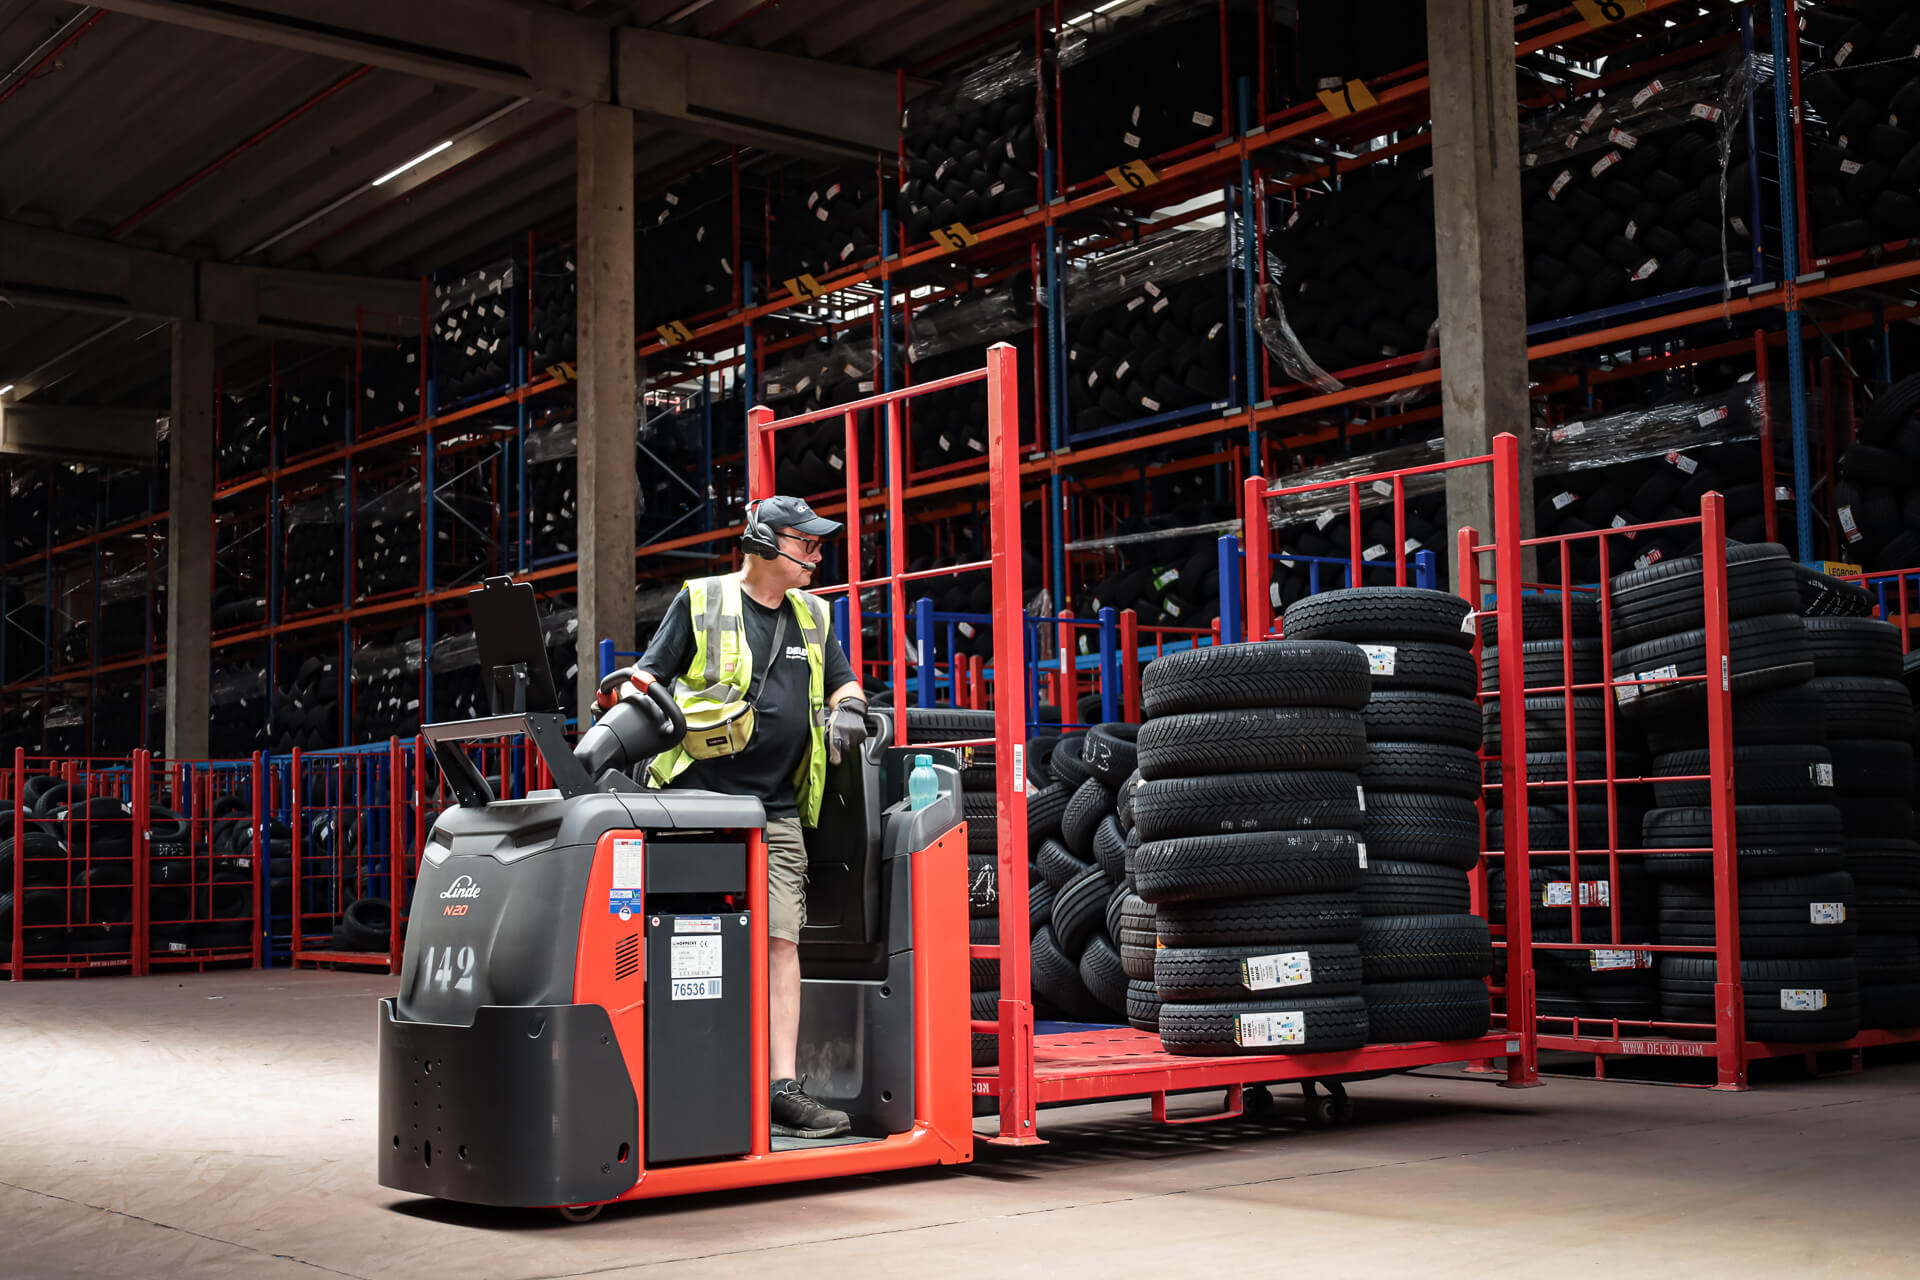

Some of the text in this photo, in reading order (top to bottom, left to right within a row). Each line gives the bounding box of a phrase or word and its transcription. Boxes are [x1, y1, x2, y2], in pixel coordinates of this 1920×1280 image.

[1593, 0, 1626, 21] 8
[1328, 83, 1357, 112] 7
[1118, 164, 1144, 188] 6
[943, 226, 967, 248] 5
[795, 277, 813, 298] 4
[665, 323, 686, 341] 3
[553, 365, 574, 380] 2
[440, 875, 480, 898] Linde
[443, 904, 469, 916] N20
[423, 946, 475, 992] 142
[673, 983, 705, 997] 76536
[1622, 1042, 1704, 1056] WWW.DELDO.COM
